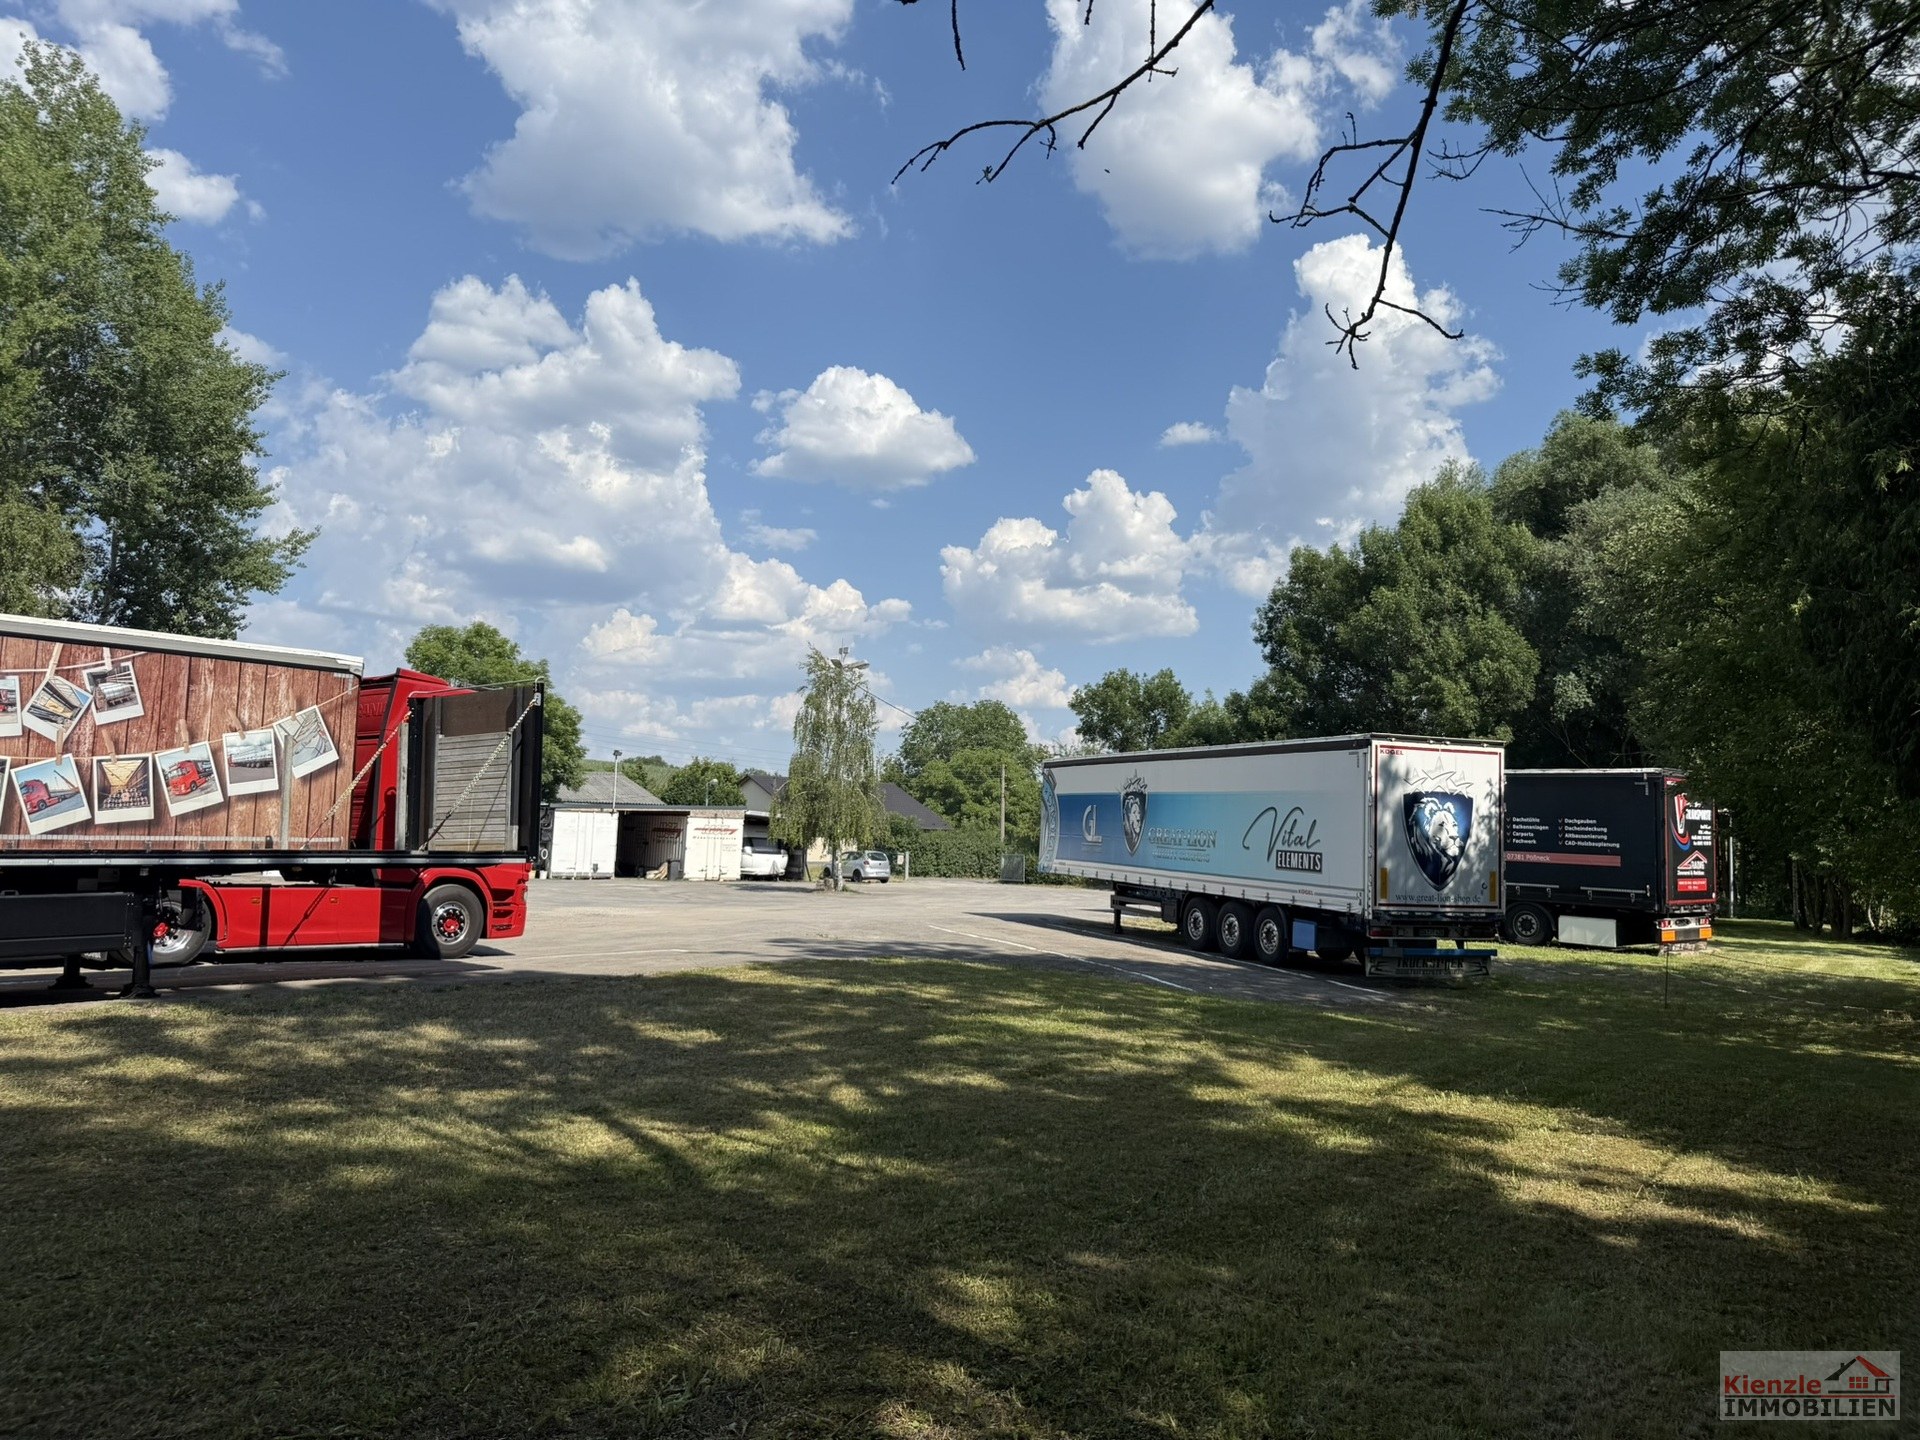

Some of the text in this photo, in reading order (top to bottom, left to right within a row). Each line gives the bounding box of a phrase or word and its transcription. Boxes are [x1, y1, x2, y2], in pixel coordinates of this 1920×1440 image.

[1242, 806, 1320, 862] Vital
[1564, 825, 1608, 833] Dacheindeckung
[1148, 827, 1218, 849] GREAT-LION
[1564, 840, 1620, 848] CAD-Holzbauplanung
[1277, 851, 1321, 871] ELEMENTS
[1506, 853, 1524, 861] 07381
[1395, 892, 1481, 904] www.great-lion-shop.de
